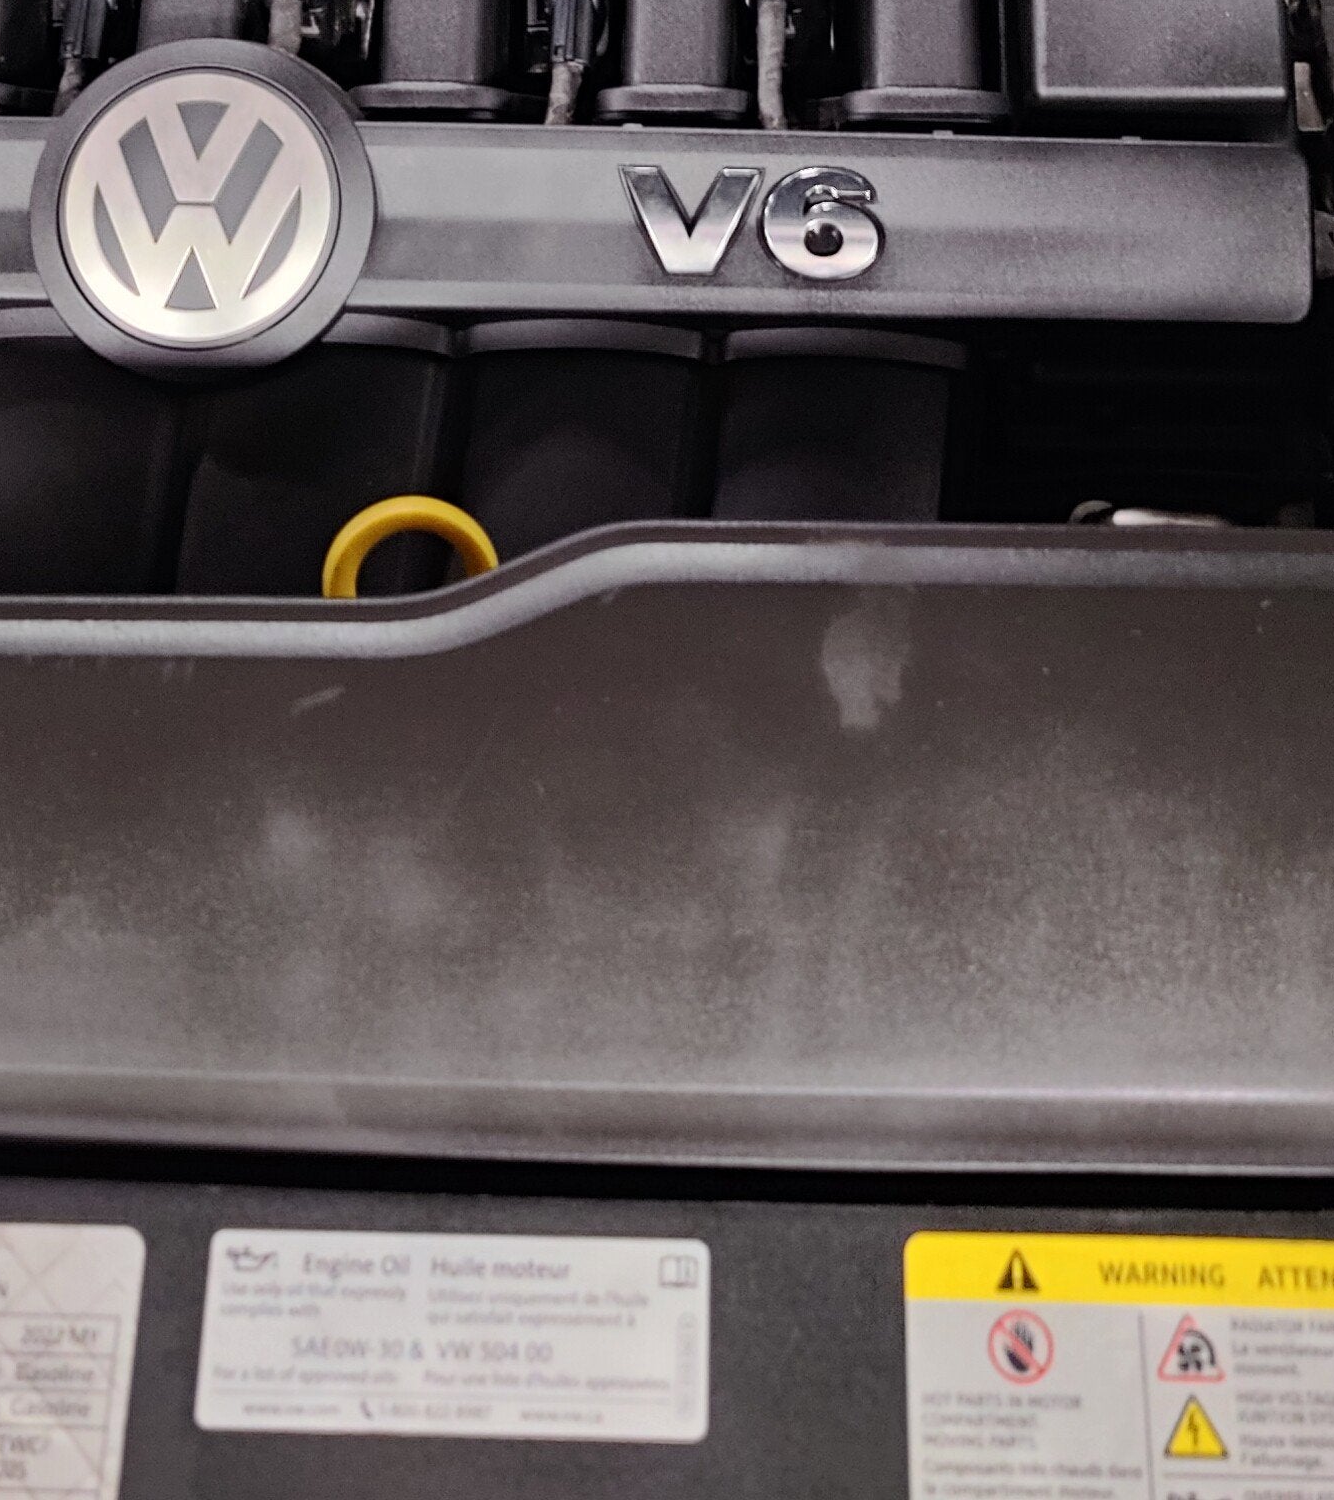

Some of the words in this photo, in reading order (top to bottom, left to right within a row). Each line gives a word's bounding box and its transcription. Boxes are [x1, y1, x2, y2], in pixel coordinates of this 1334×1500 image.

[618, 162, 885, 281] V6
[303, 1253, 374, 1278] Engine
[380, 1254, 411, 1276] Oil
[430, 1256, 485, 1277] Huile
[491, 1261, 572, 1280] moteur
[1098, 1260, 1225, 1288] WARNING
[436, 1339, 474, 1362] VW
[480, 1339, 520, 1363] 504
